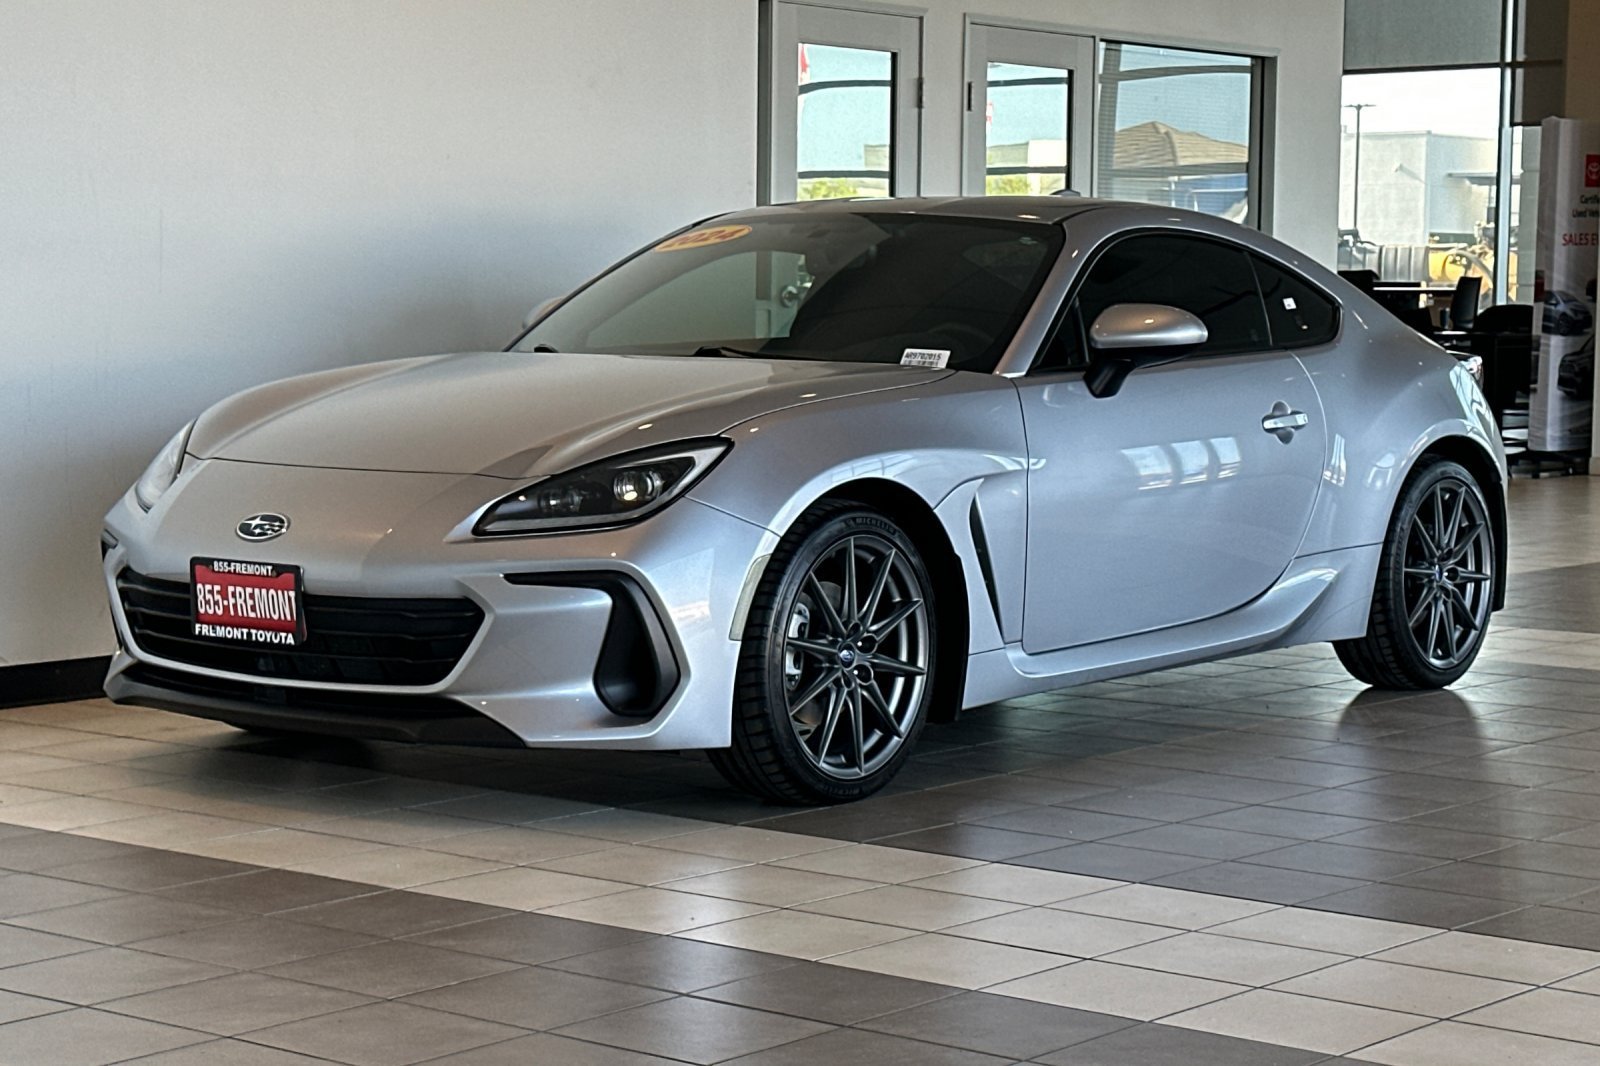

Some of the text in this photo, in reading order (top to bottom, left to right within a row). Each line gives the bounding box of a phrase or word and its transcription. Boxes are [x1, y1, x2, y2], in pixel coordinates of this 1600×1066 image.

[1562, 232, 1589, 246] SALES
[213, 560, 273, 576] 855-FREMONT
[196, 583, 296, 621] 855-FREMONT
